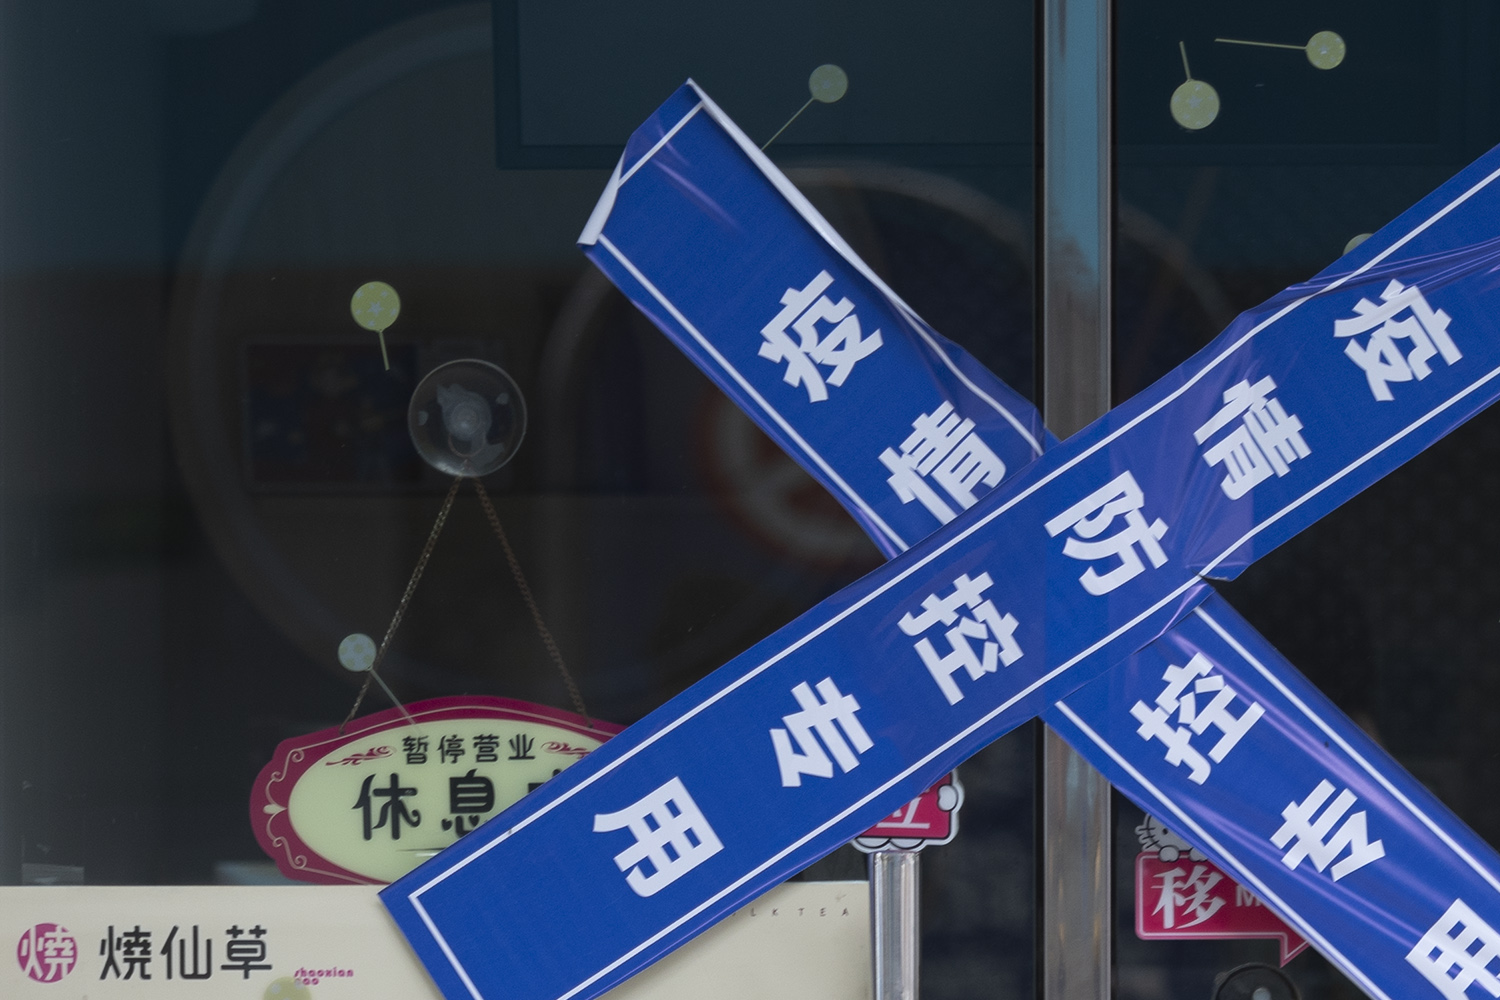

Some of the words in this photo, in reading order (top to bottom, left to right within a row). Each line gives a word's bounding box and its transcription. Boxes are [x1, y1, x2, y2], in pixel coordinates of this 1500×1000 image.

[593, 278, 1463, 897] 疫情防控专用
[402, 733, 537, 764] 暂停营业
[352, 768, 564, 841] 休息
[797, 907, 850, 917] TEA
[1151, 865, 1226, 929] 移
